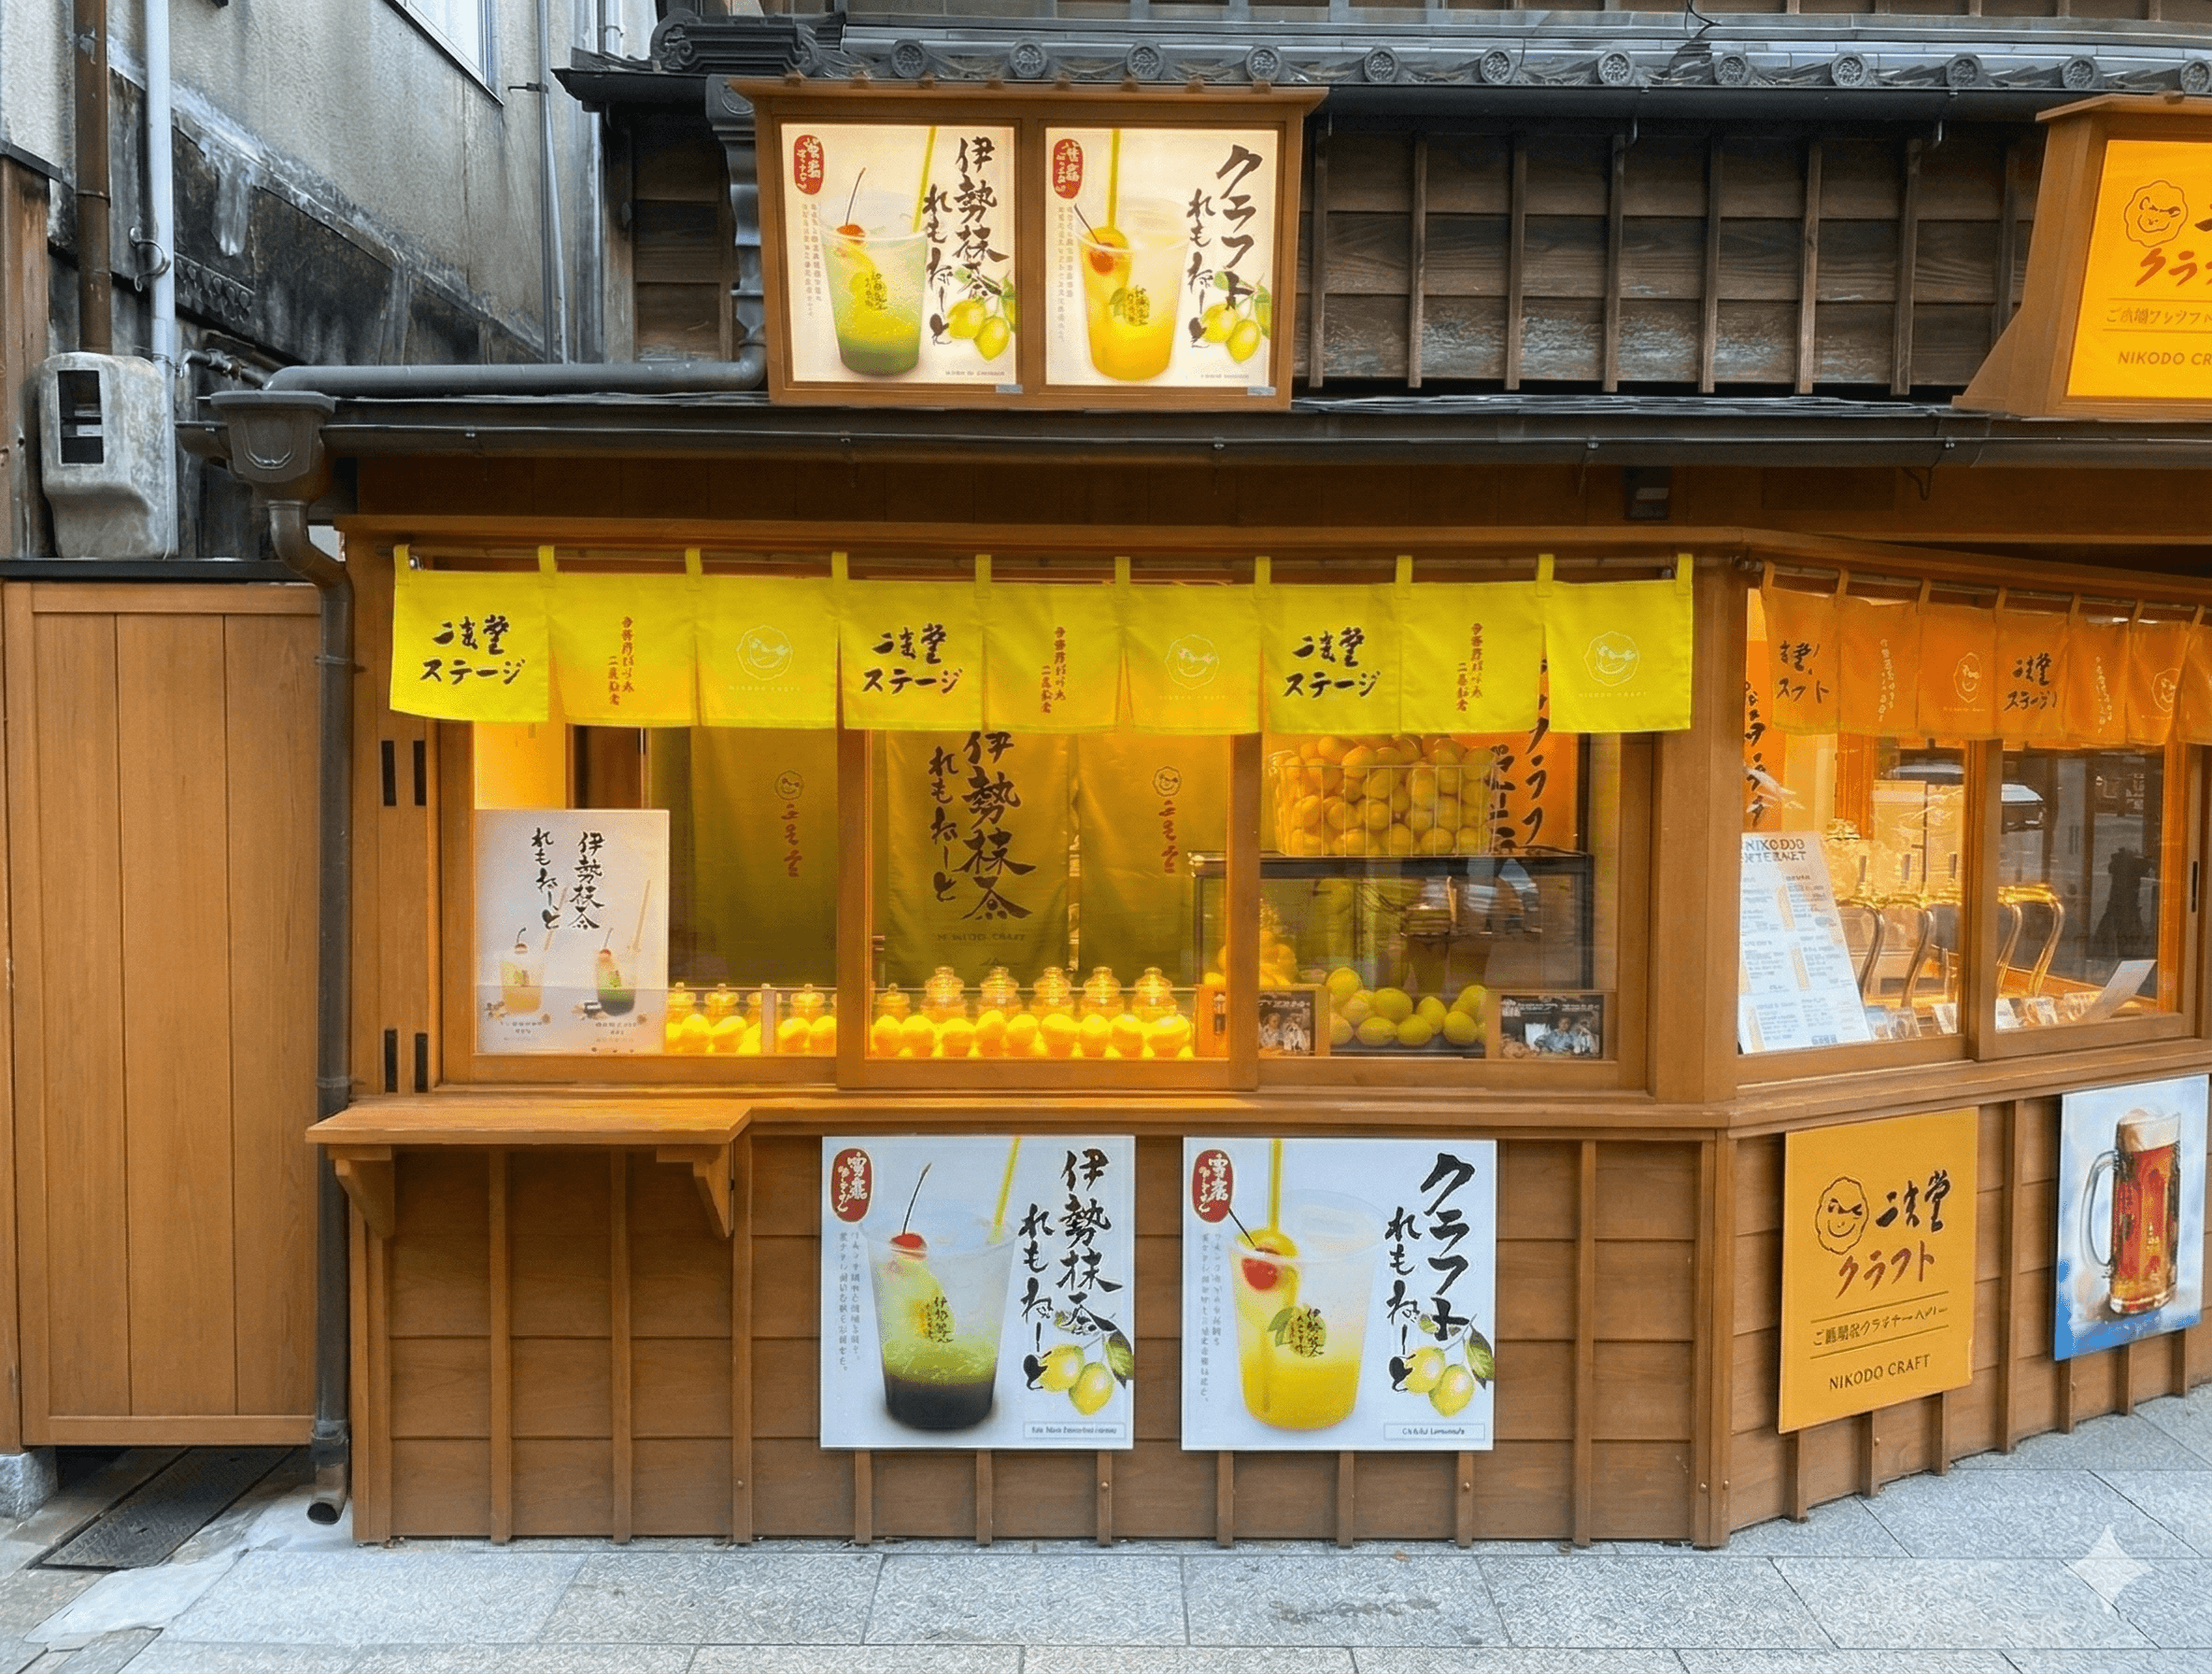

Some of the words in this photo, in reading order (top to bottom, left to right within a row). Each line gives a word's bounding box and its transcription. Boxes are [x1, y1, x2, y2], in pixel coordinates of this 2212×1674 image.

[2134, 248, 2212, 287] クラ
[2118, 351, 2186, 365] NIKODO
[419, 658, 526, 686] ステージ
[862, 668, 962, 694] ステージ
[1282, 671, 1381, 698] ステージ
[1836, 1240, 1935, 1299] クラフト
[1829, 1365, 1883, 1391] NIKODO
[1888, 1354, 1931, 1376] CRAFT
